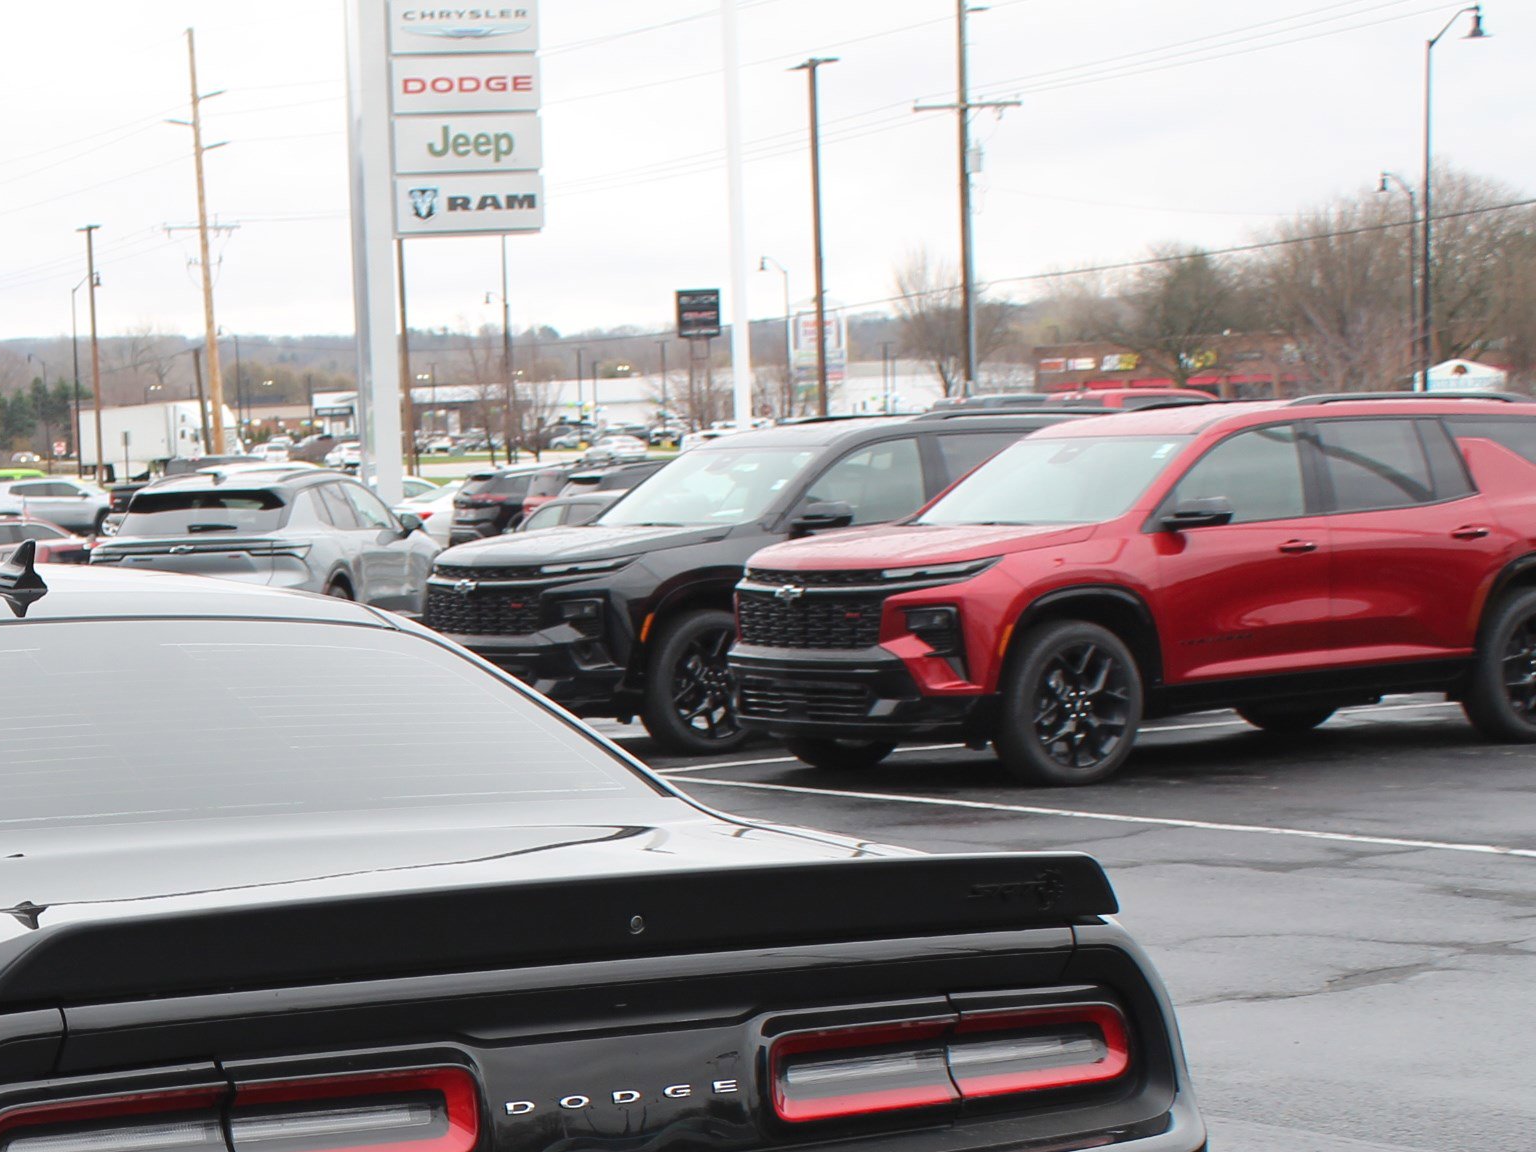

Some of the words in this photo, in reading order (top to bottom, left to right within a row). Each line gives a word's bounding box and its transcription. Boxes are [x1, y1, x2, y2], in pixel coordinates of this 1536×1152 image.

[402, 8, 528, 21] CHRYSLER
[402, 75, 533, 95] DODGE
[427, 125, 514, 162] Jeep
[447, 194, 536, 212] RAM
[505, 1079, 738, 1115] DODGE
